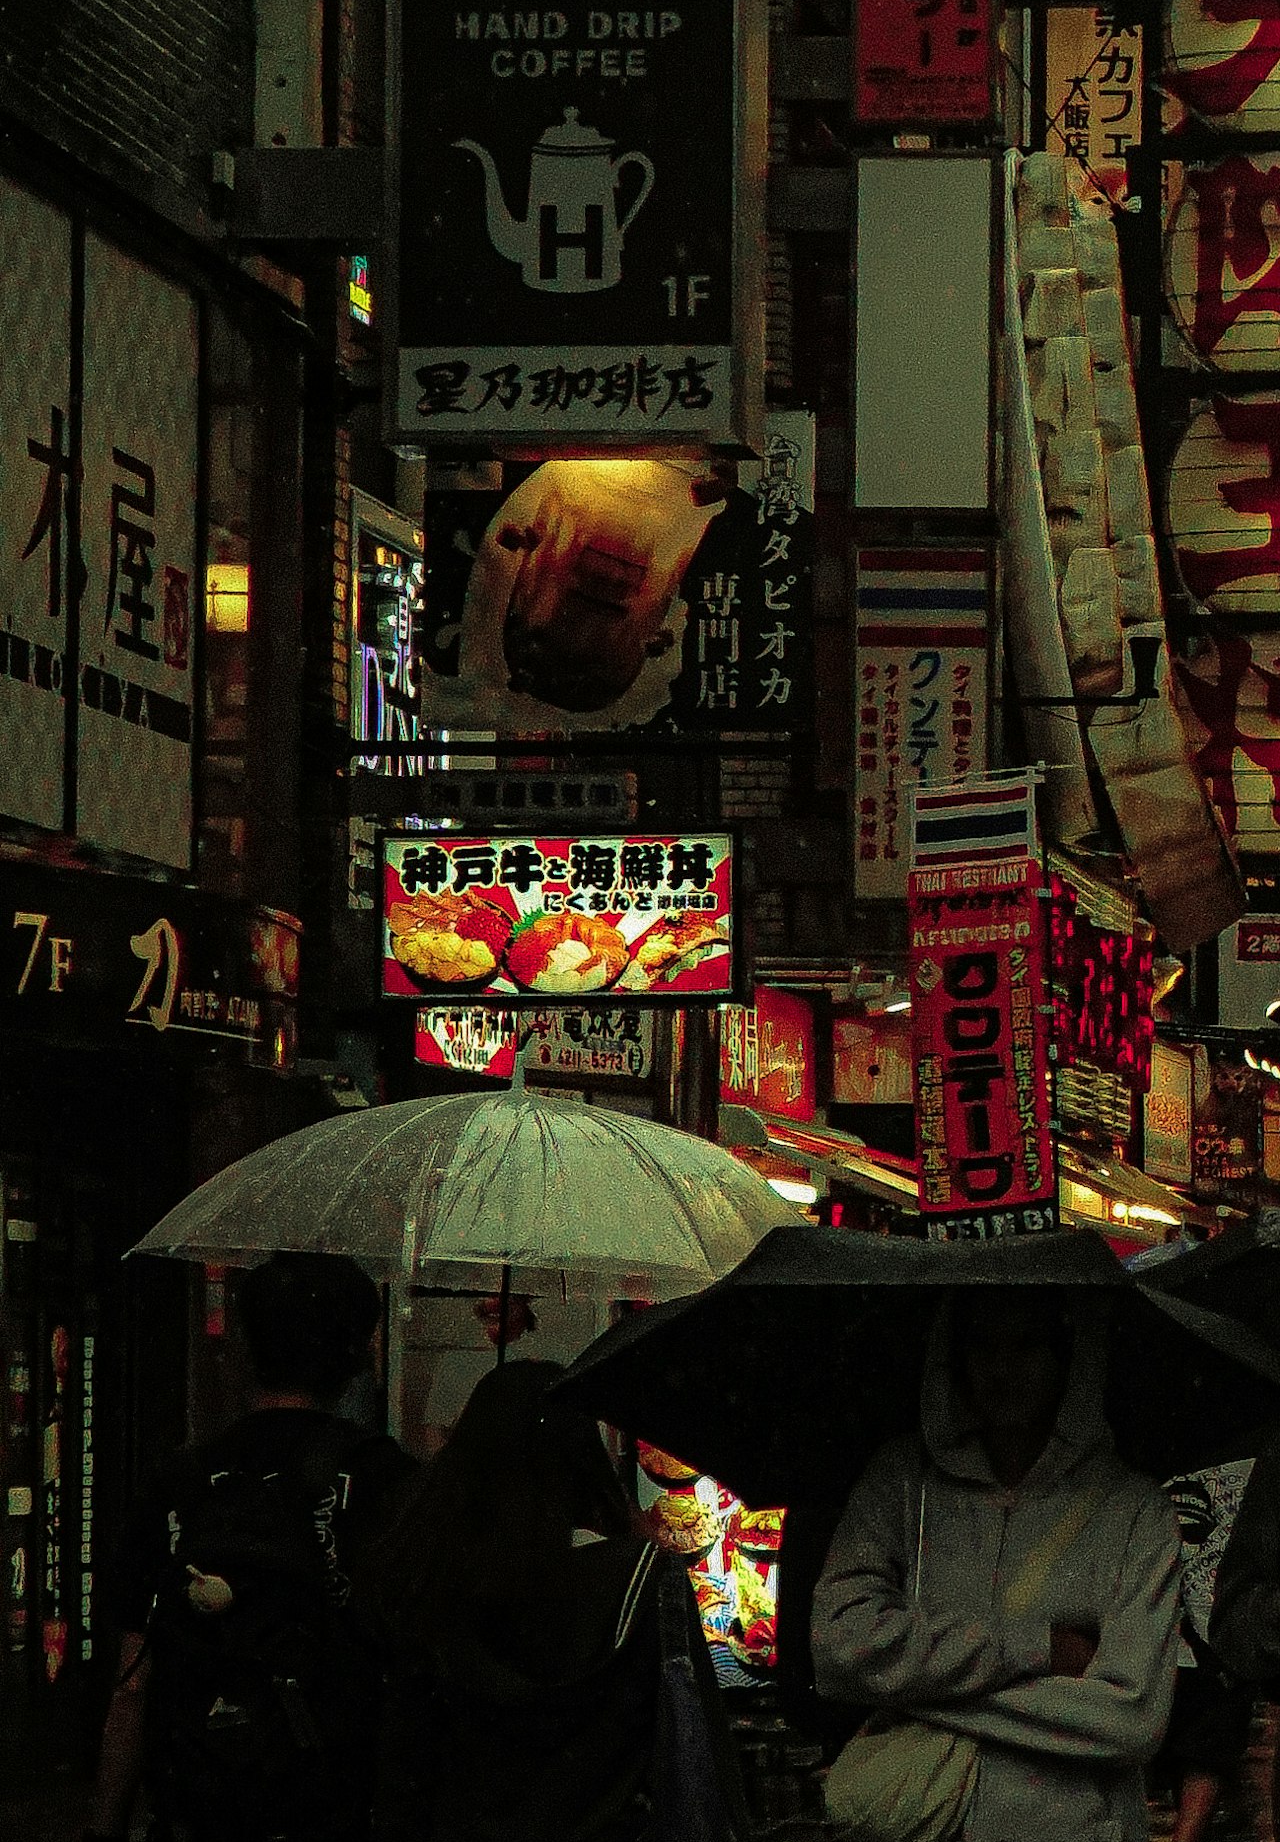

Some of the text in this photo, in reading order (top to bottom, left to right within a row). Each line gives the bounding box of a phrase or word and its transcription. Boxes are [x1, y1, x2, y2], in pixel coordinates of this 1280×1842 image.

[454, 10, 682, 42] HAND DRIP
[491, 48, 649, 79] COFFEE
[540, 204, 603, 280] H
[661, 275, 711, 317] 1F
[416, 355, 722, 421] 星乃珈琲店
[755, 435, 801, 708] 台湾タピオカ
[696, 571, 740, 711] 専門店
[403, 843, 715, 894] 神戸牛と海鮮丼
